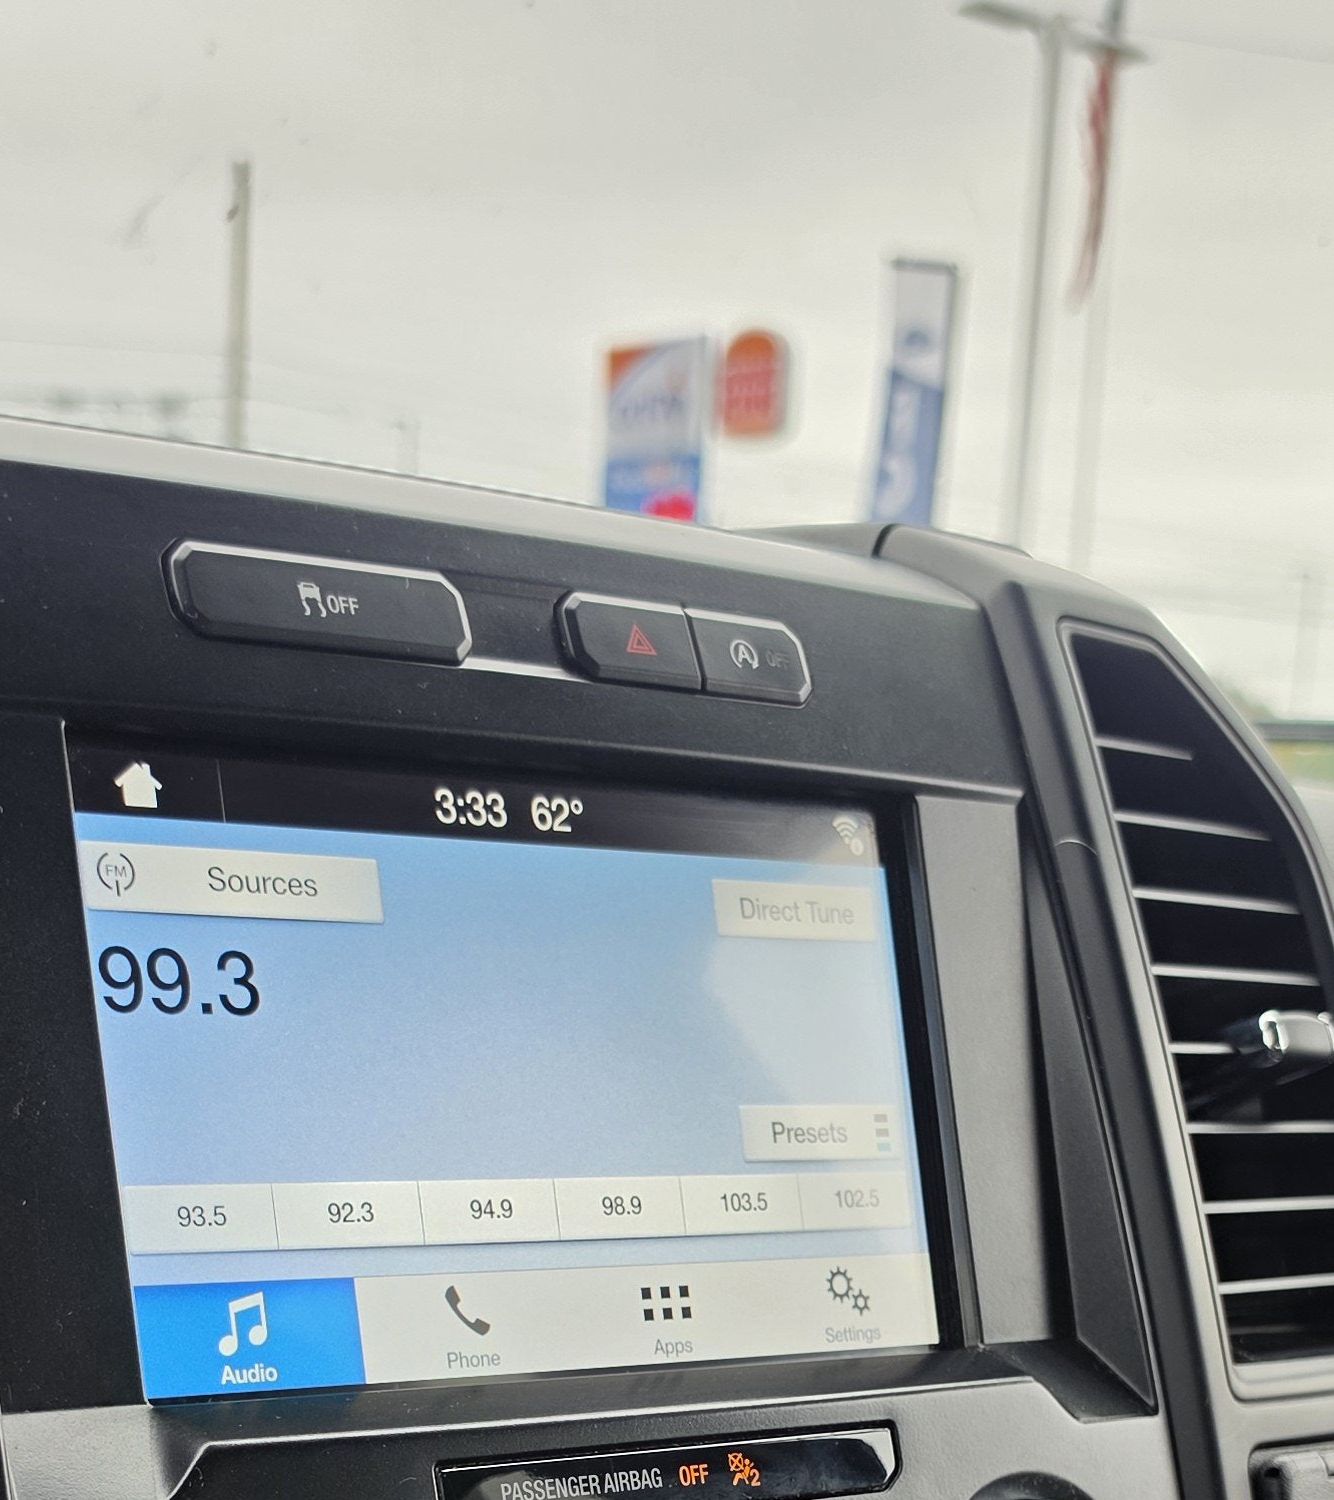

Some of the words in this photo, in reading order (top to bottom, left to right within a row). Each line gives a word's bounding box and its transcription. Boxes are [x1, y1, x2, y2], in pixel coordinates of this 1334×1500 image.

[326, 594, 359, 615] OFF
[434, 787, 508, 828] 3:33
[105, 863, 128, 879] FM
[207, 865, 319, 898] Sources
[739, 896, 802, 923] Direct
[805, 900, 855, 925] Tune
[98, 945, 261, 1017] 99.3
[770, 1121, 849, 1144] Presets
[469, 1199, 514, 1221] 94.9
[601, 1195, 643, 1217] 98.9
[720, 1192, 768, 1213] 103.5
[834, 1188, 881, 1210] 102.5
[177, 1204, 228, 1228] 93.5
[327, 1201, 376, 1224] 92.3
[824, 1325, 882, 1345] Settings
[446, 1350, 502, 1370] Phone
[653, 1338, 694, 1359] Apps
[220, 1362, 279, 1386] Audio
[604, 1467, 664, 1495] AIRBAG
[678, 1463, 709, 1487] OFF
